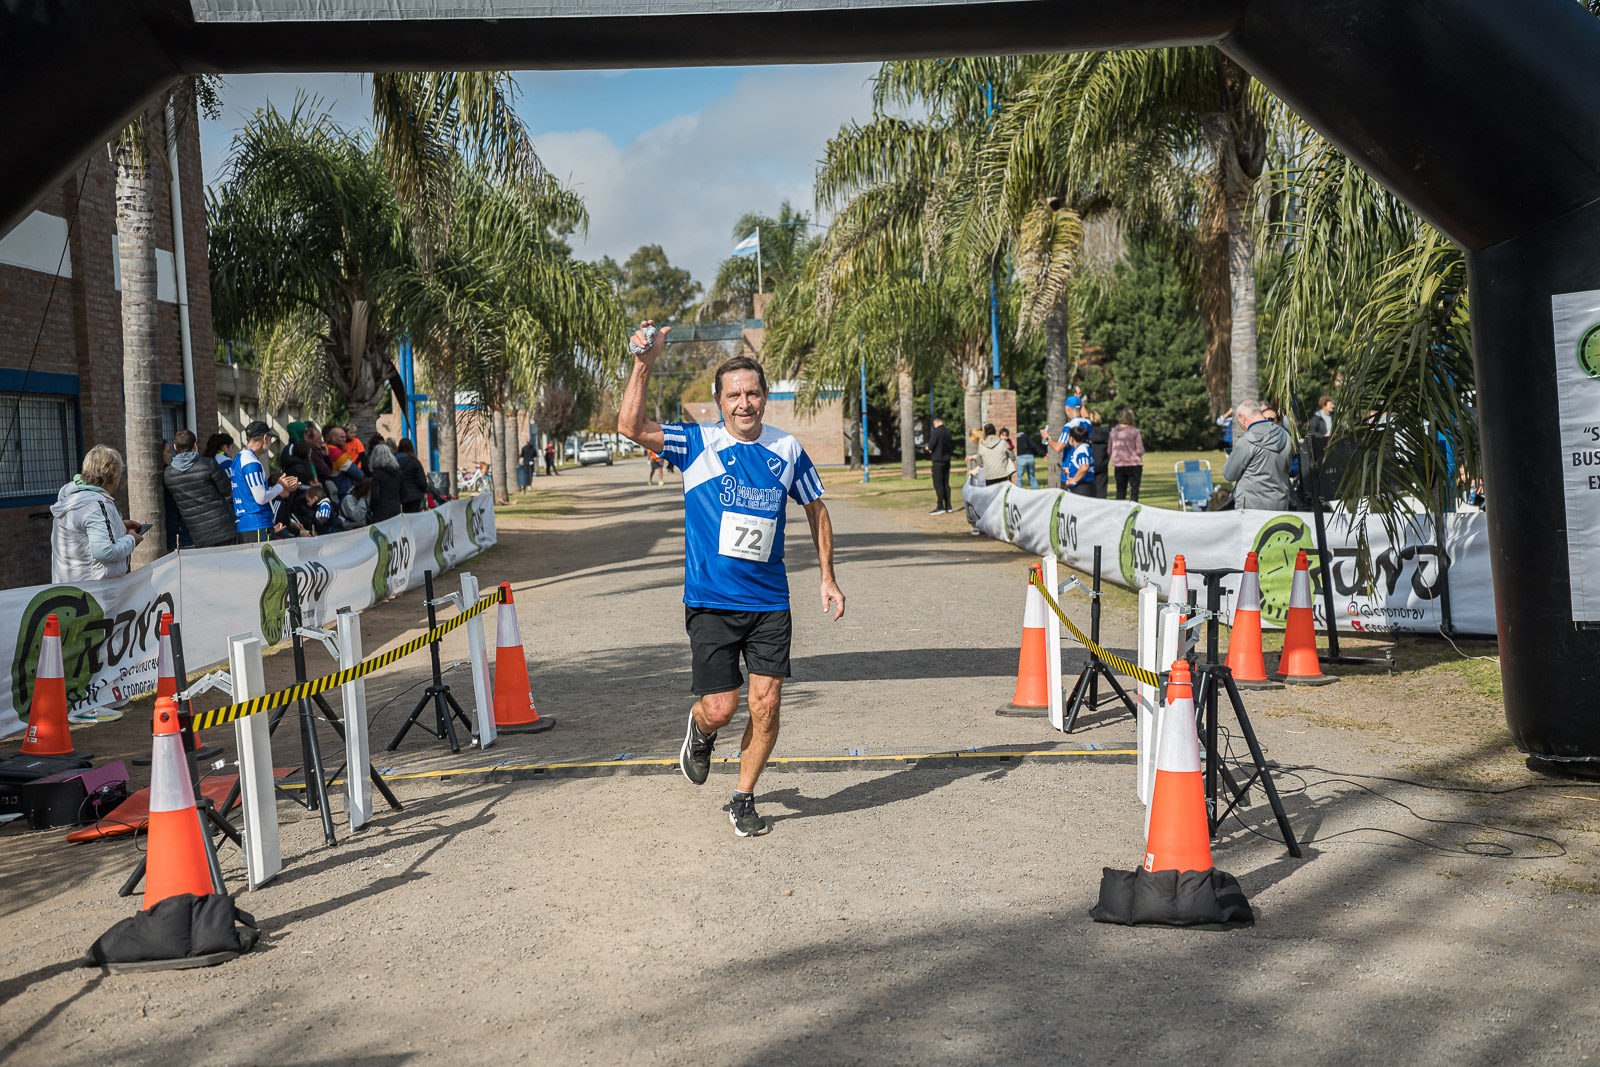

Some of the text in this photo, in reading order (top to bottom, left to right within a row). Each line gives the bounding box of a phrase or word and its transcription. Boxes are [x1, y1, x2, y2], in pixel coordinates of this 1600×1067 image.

[1573, 451, 1600, 466] BUS
[720, 474, 737, 507] 3
[734, 526, 763, 551] 72
[122, 679, 156, 698] cronorav
